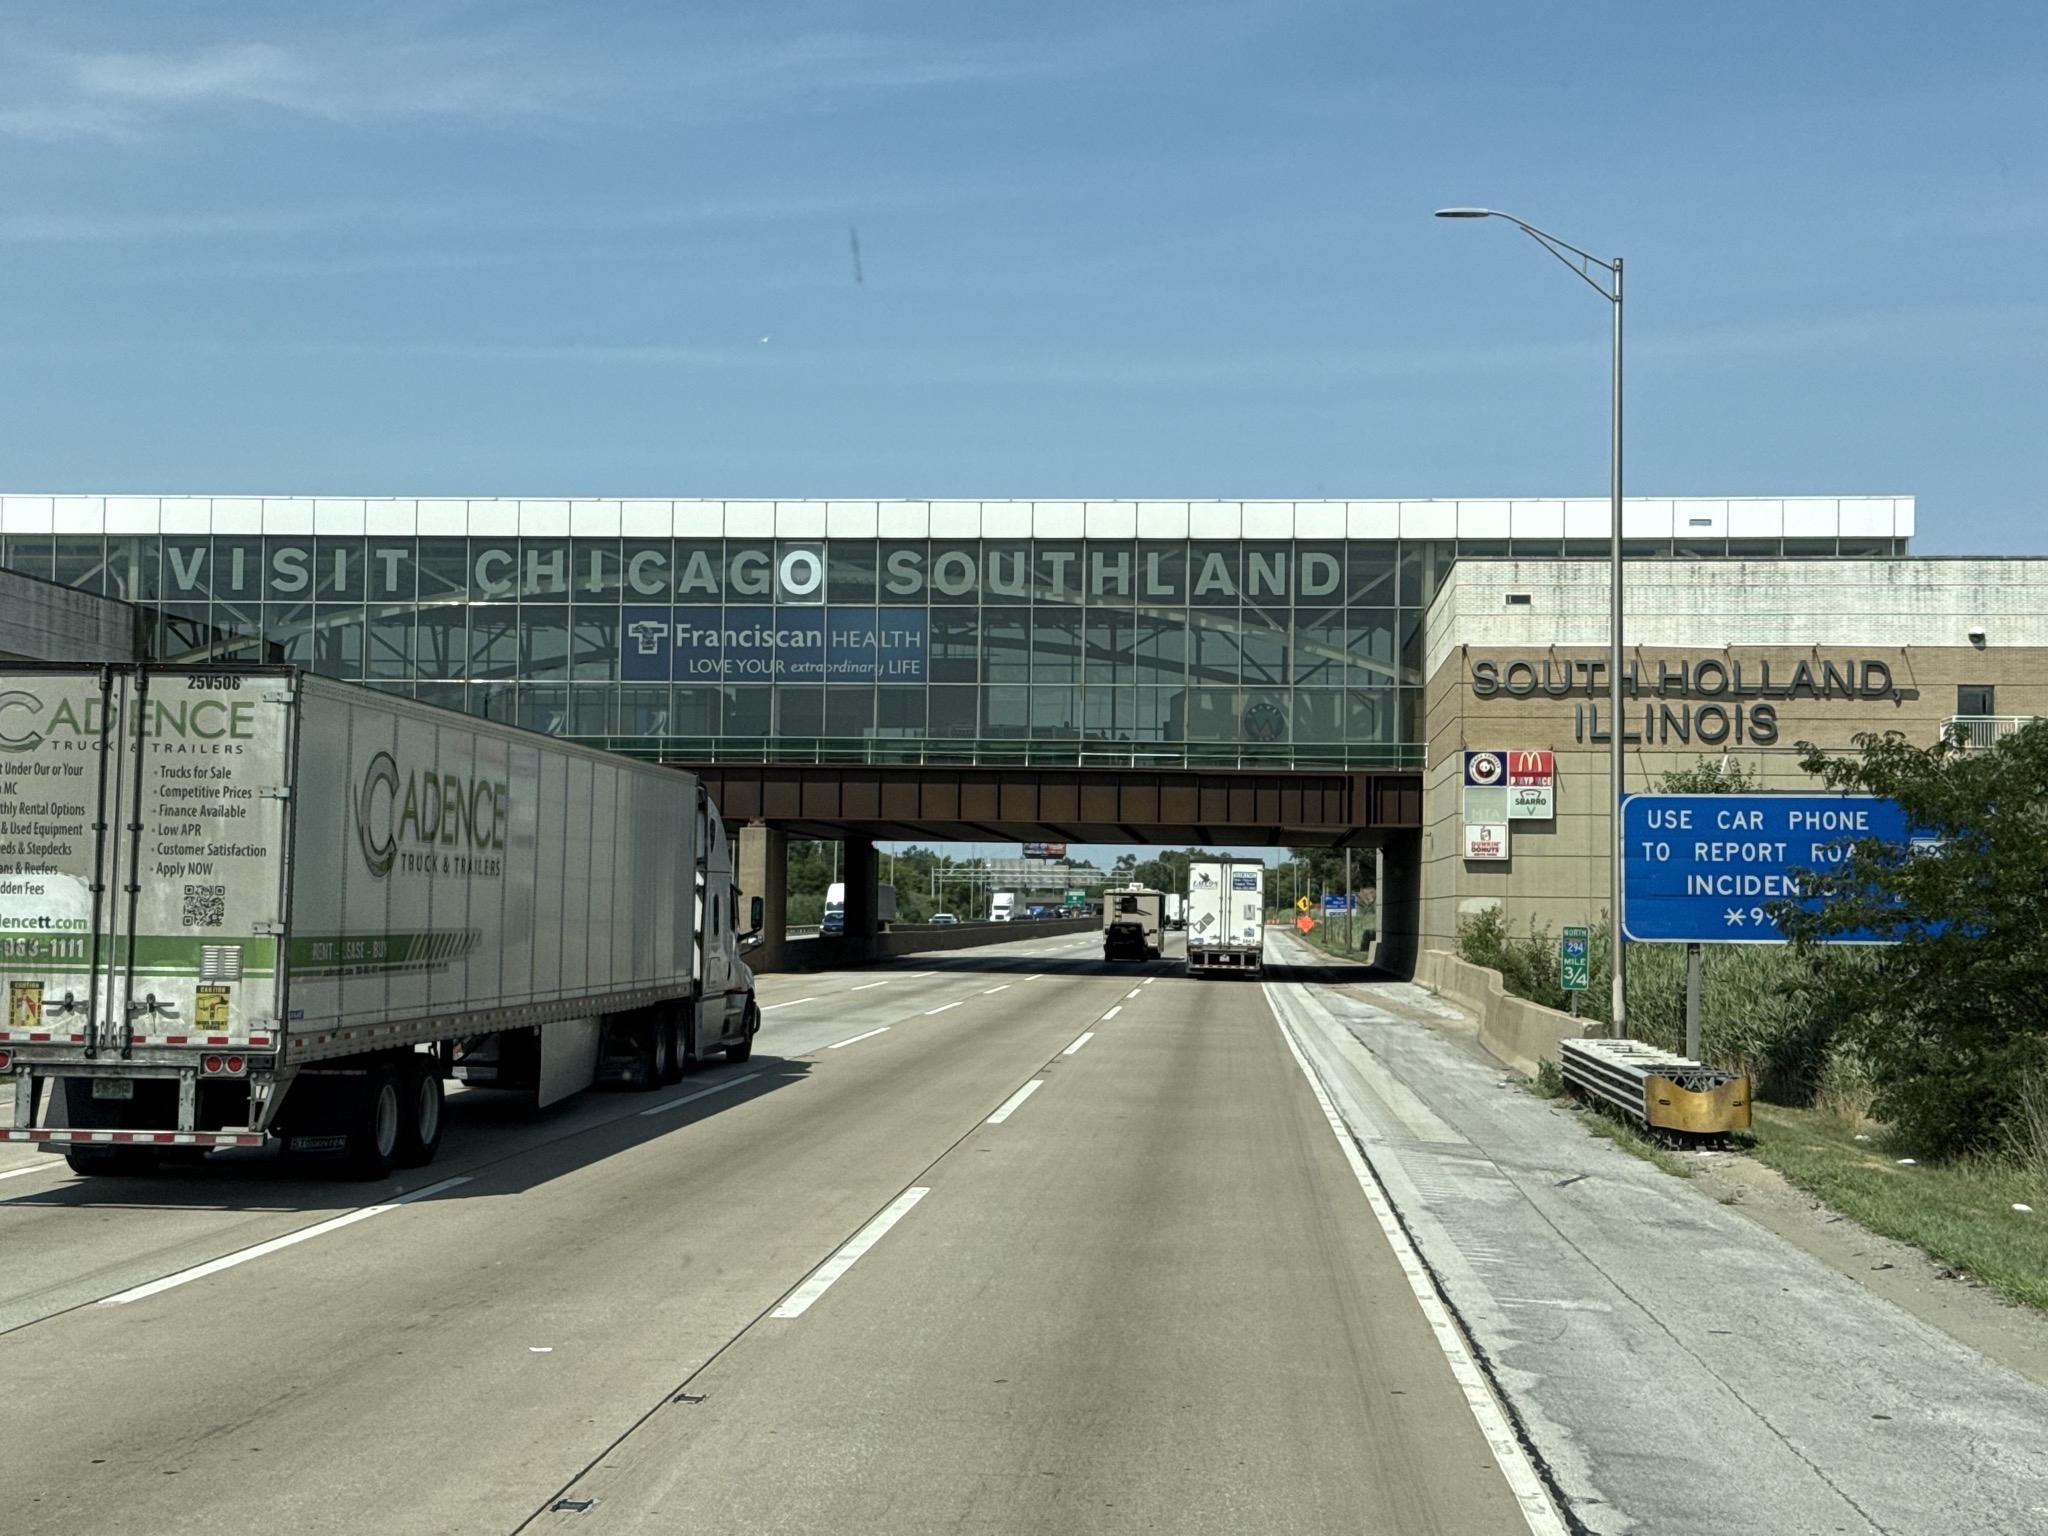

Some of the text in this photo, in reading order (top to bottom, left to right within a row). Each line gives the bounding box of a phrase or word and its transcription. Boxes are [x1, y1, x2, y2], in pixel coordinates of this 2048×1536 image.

[168, 547, 1340, 596] VISIT CHICAGO SOUTHLAND
[676, 624, 921, 648] Franciscan HEALTH
[689, 659, 921, 677] LOVE YOUR extraordinary LIFE
[1472, 659, 1902, 706] SOUTH HOLLAND,
[0, 690, 254, 746] CADENCE
[52, 741, 114, 751] TRUCK
[152, 744, 243, 754] TRAILERS
[5, 762, 33, 775] Under
[34, 762, 50, 775] Our
[52, 765, 62, 775] or
[63, 763, 84, 776] Your
[160, 765, 231, 779] Trucks for Sale
[4, 782, 18, 795] MC
[160, 785, 252, 800] Competitive Prices
[19, 802, 49, 815] Rental
[51, 802, 85, 818] Options
[357, 751, 506, 864] CADENCE
[1515, 798, 1547, 806] SBARRO
[159, 804, 246, 818] Finance Available
[1648, 810, 1869, 831] USE CAR PHONE
[1, 822, 83, 838] & Used Equipment
[158, 823, 201, 836] Low APR
[18, 842, 26, 855] &
[27, 842, 72, 858] Stepdecks
[157, 842, 266, 857] Customer Satisfaction
[1642, 842, 1857, 863] TO REPORT ROA
[16, 862, 23, 875] &
[25, 862, 58, 875] Reefers
[156, 862, 213, 878] Apply NOW
[401, 853, 501, 876] TRUCK & TRAILERS
[25, 882, 45, 895] Fees
[1688, 874, 1837, 897] INCIDEN
[0, 914, 87, 930] encett.com
[312, 942, 333, 961] RENT
[1567, 942, 1583, 953] 294
[1563, 958, 1586, 966] MILE
